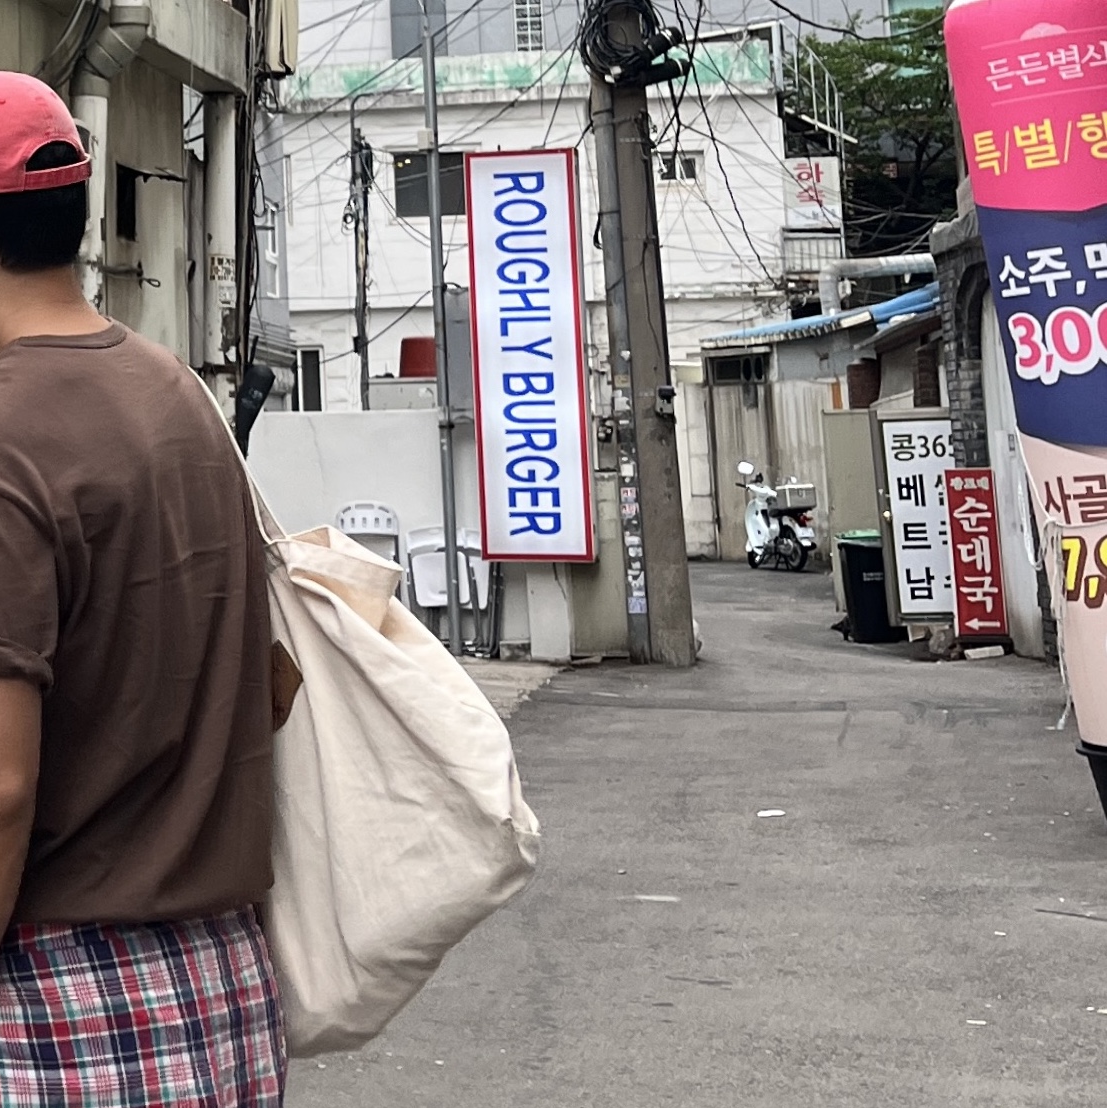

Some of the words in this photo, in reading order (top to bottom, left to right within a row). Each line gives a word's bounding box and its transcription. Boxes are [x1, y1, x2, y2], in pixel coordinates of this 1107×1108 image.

[492, 171, 553, 361] ROUGHLY
[1009, 303, 1107, 378] 3,0
[502, 371, 562, 536] BURGER
[897, 473, 935, 601] 베트남
[953, 496, 999, 614] 순대국
